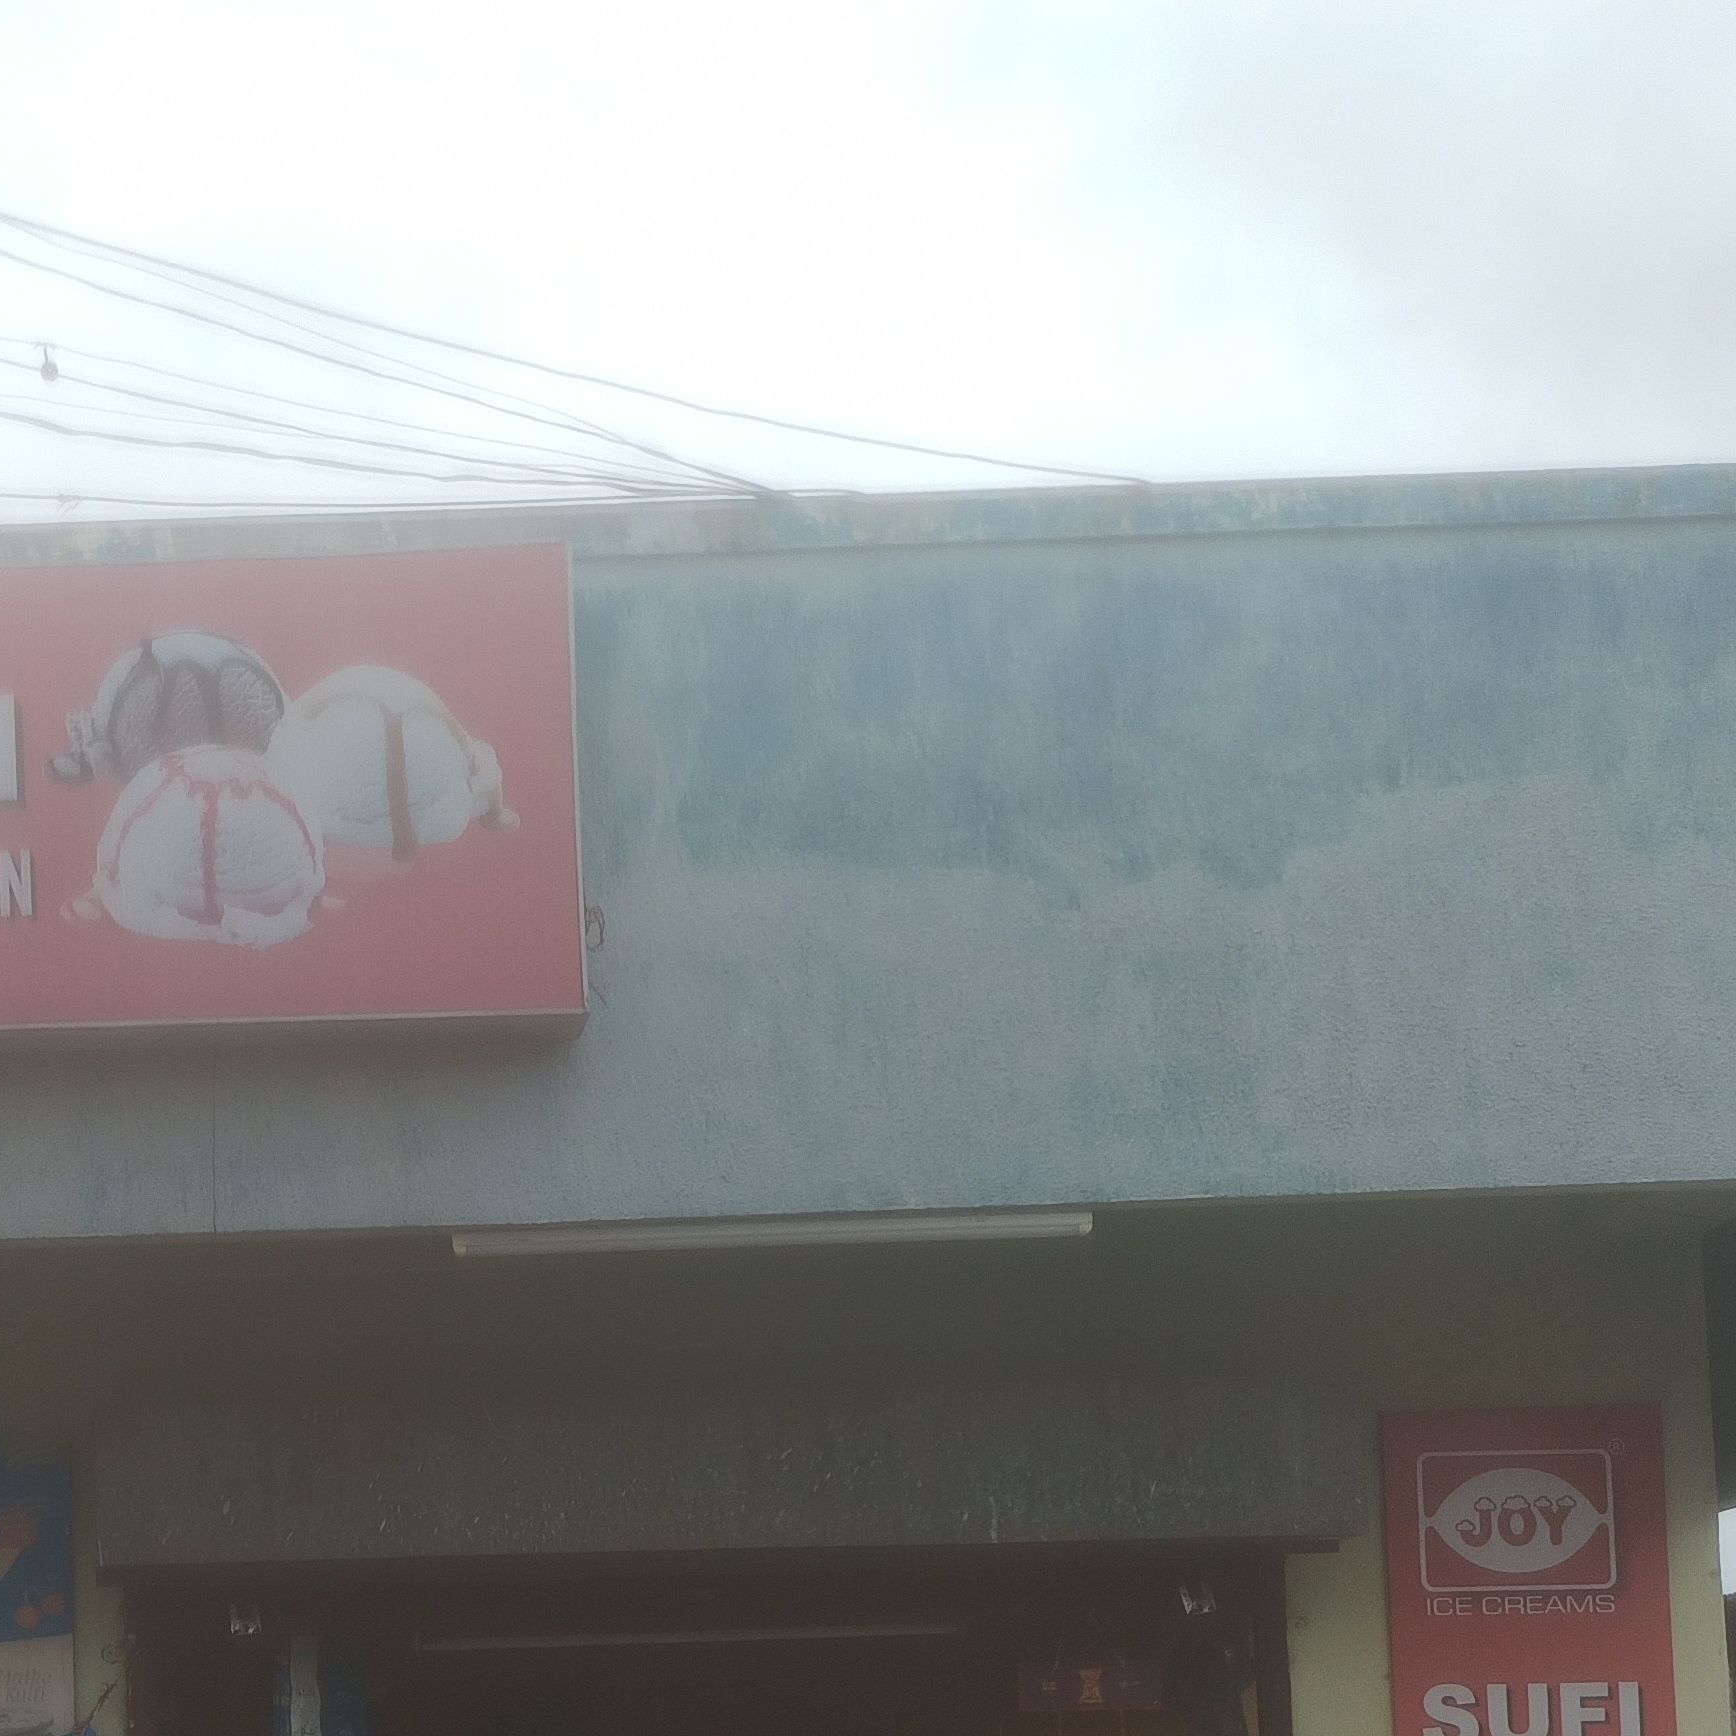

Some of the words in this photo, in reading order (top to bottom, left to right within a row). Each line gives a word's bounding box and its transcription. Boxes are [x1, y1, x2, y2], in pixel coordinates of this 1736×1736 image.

[1456, 1495, 1577, 1547] JOY
[1426, 1597, 1473, 1616] ICE
[1482, 1594, 1616, 1615] CREAMS
